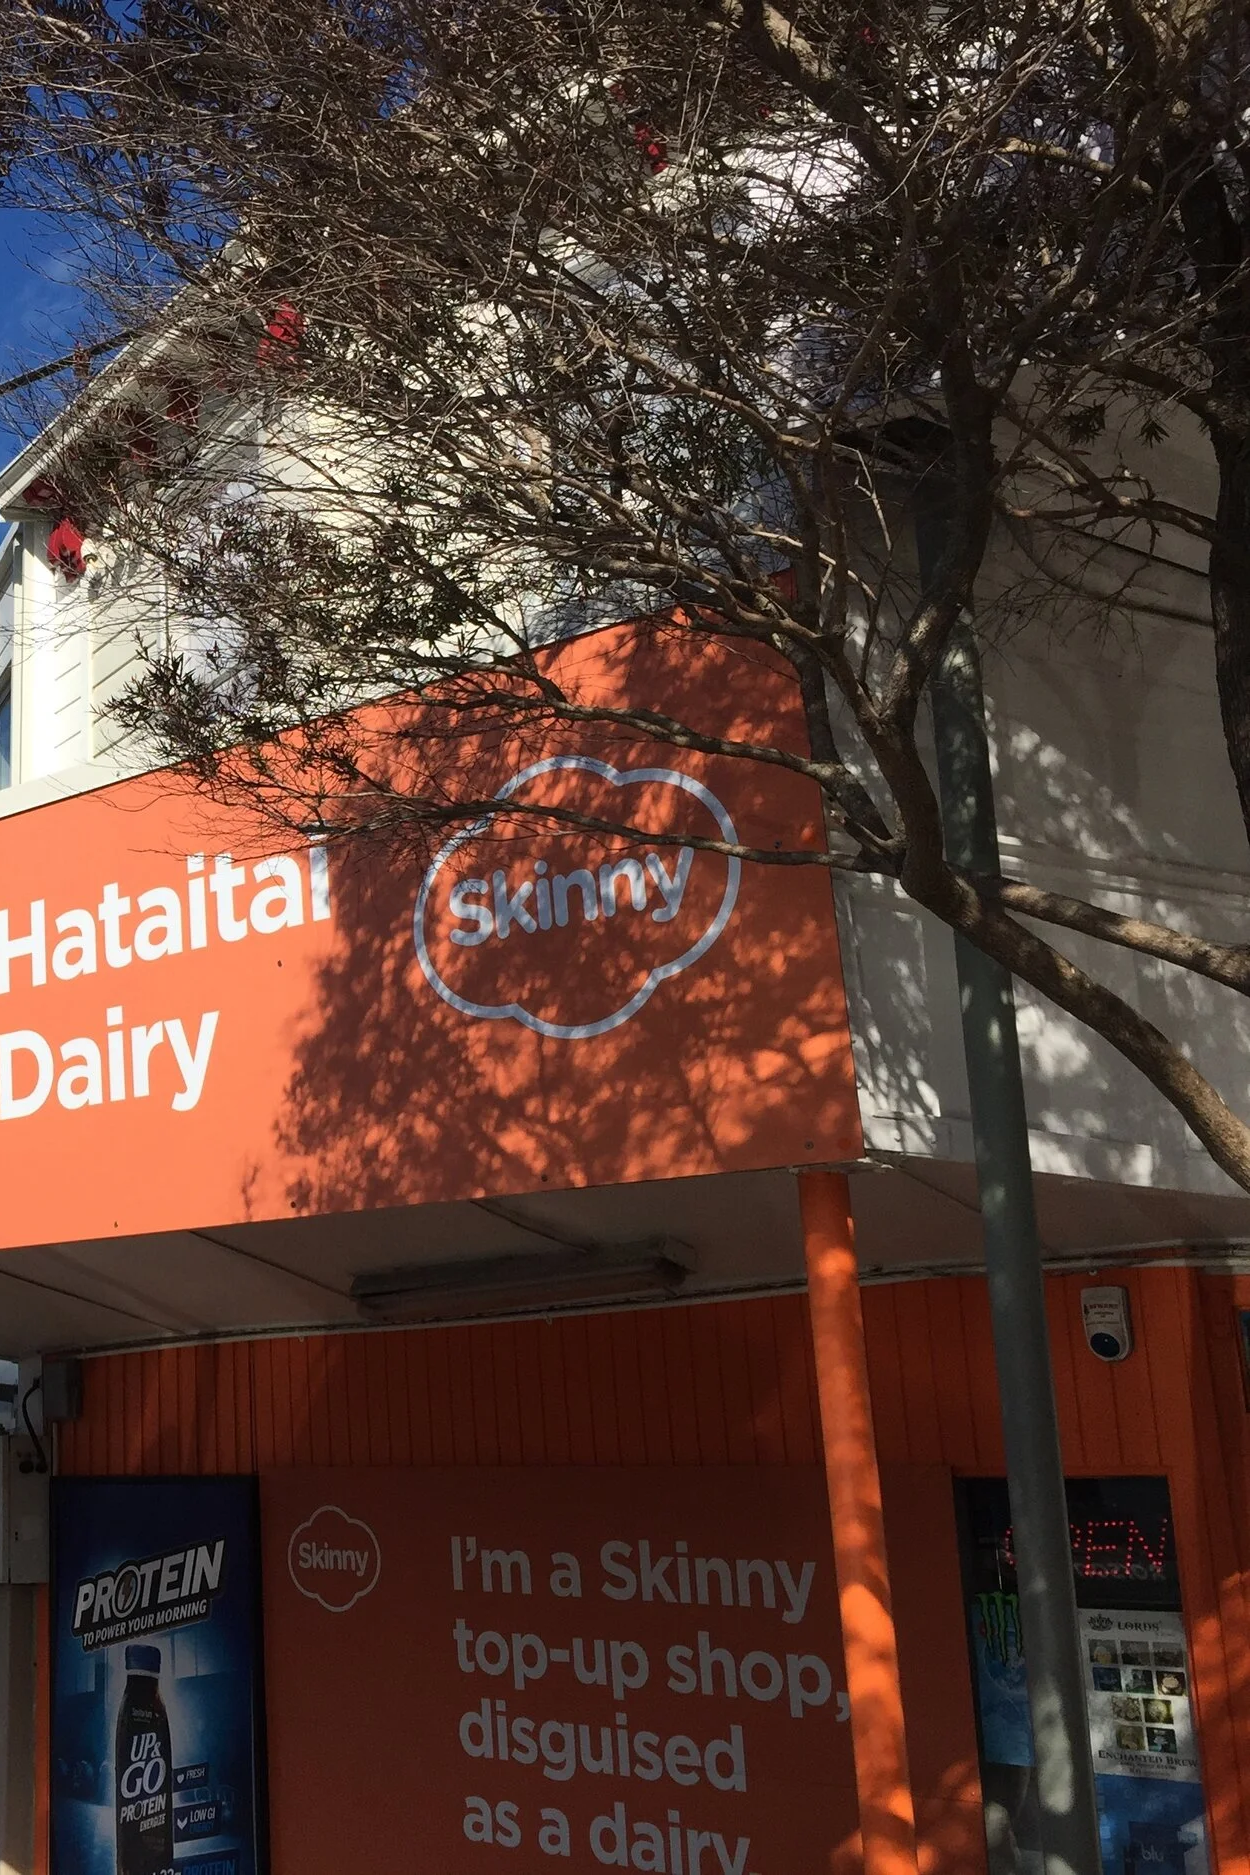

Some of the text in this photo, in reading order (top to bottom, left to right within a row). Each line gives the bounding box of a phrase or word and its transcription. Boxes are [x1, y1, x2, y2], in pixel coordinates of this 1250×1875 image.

[449, 846, 695, 947] Skinny
[73, 1540, 225, 1629] PROTEIN
[298, 1541, 369, 1578] Skinny
[450, 1536, 817, 1624] I'm a Skinny
[83, 1599, 207, 1647] TO POWER YOUR MORNING
[1118, 1621, 1159, 1632] LORDS
[453, 1617, 851, 1722] top-up shop,
[459, 1697, 748, 1793] disguised
[120, 1757, 167, 1799] GO
[119, 1793, 167, 1825] PROTEIN
[190, 1808, 207, 1823] LOW
[462, 1795, 522, 1849] as
[538, 1807, 572, 1857] a
